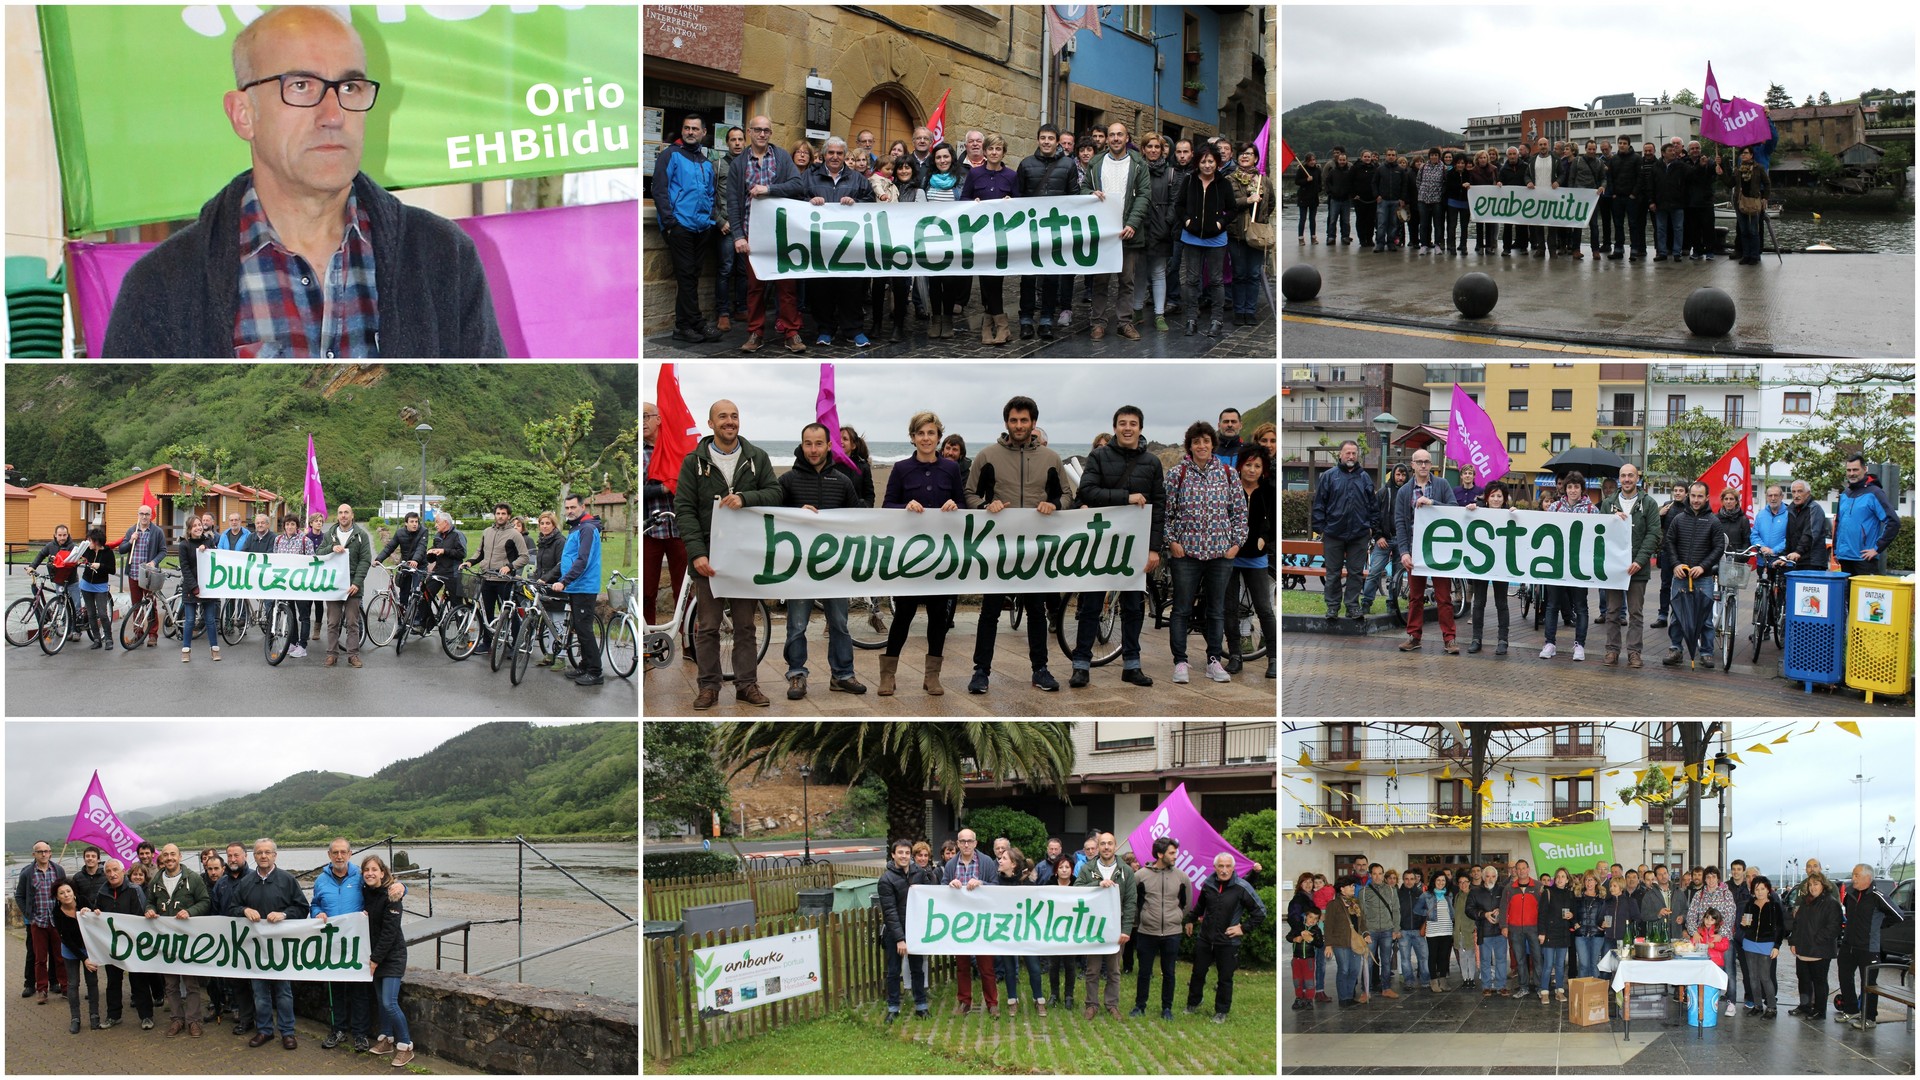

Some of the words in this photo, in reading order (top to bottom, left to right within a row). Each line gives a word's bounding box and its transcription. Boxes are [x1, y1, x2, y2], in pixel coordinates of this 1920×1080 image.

[1474, 190, 1589, 222] eraberritu
[775, 207, 1100, 274] biziberritu
[1421, 517, 1608, 582] estali
[205, 552, 339, 593] bultzatu
[1802, 585, 1820, 593] PAPERA
[1864, 590, 1885, 600] ONTZIAK
[1515, 811, 1520, 820] 4
[1525, 810, 1530, 819] 2
[90, 808, 140, 864] ehbild
[1549, 841, 1605, 859] ehbildu
[724, 950, 784, 973] anibarko
